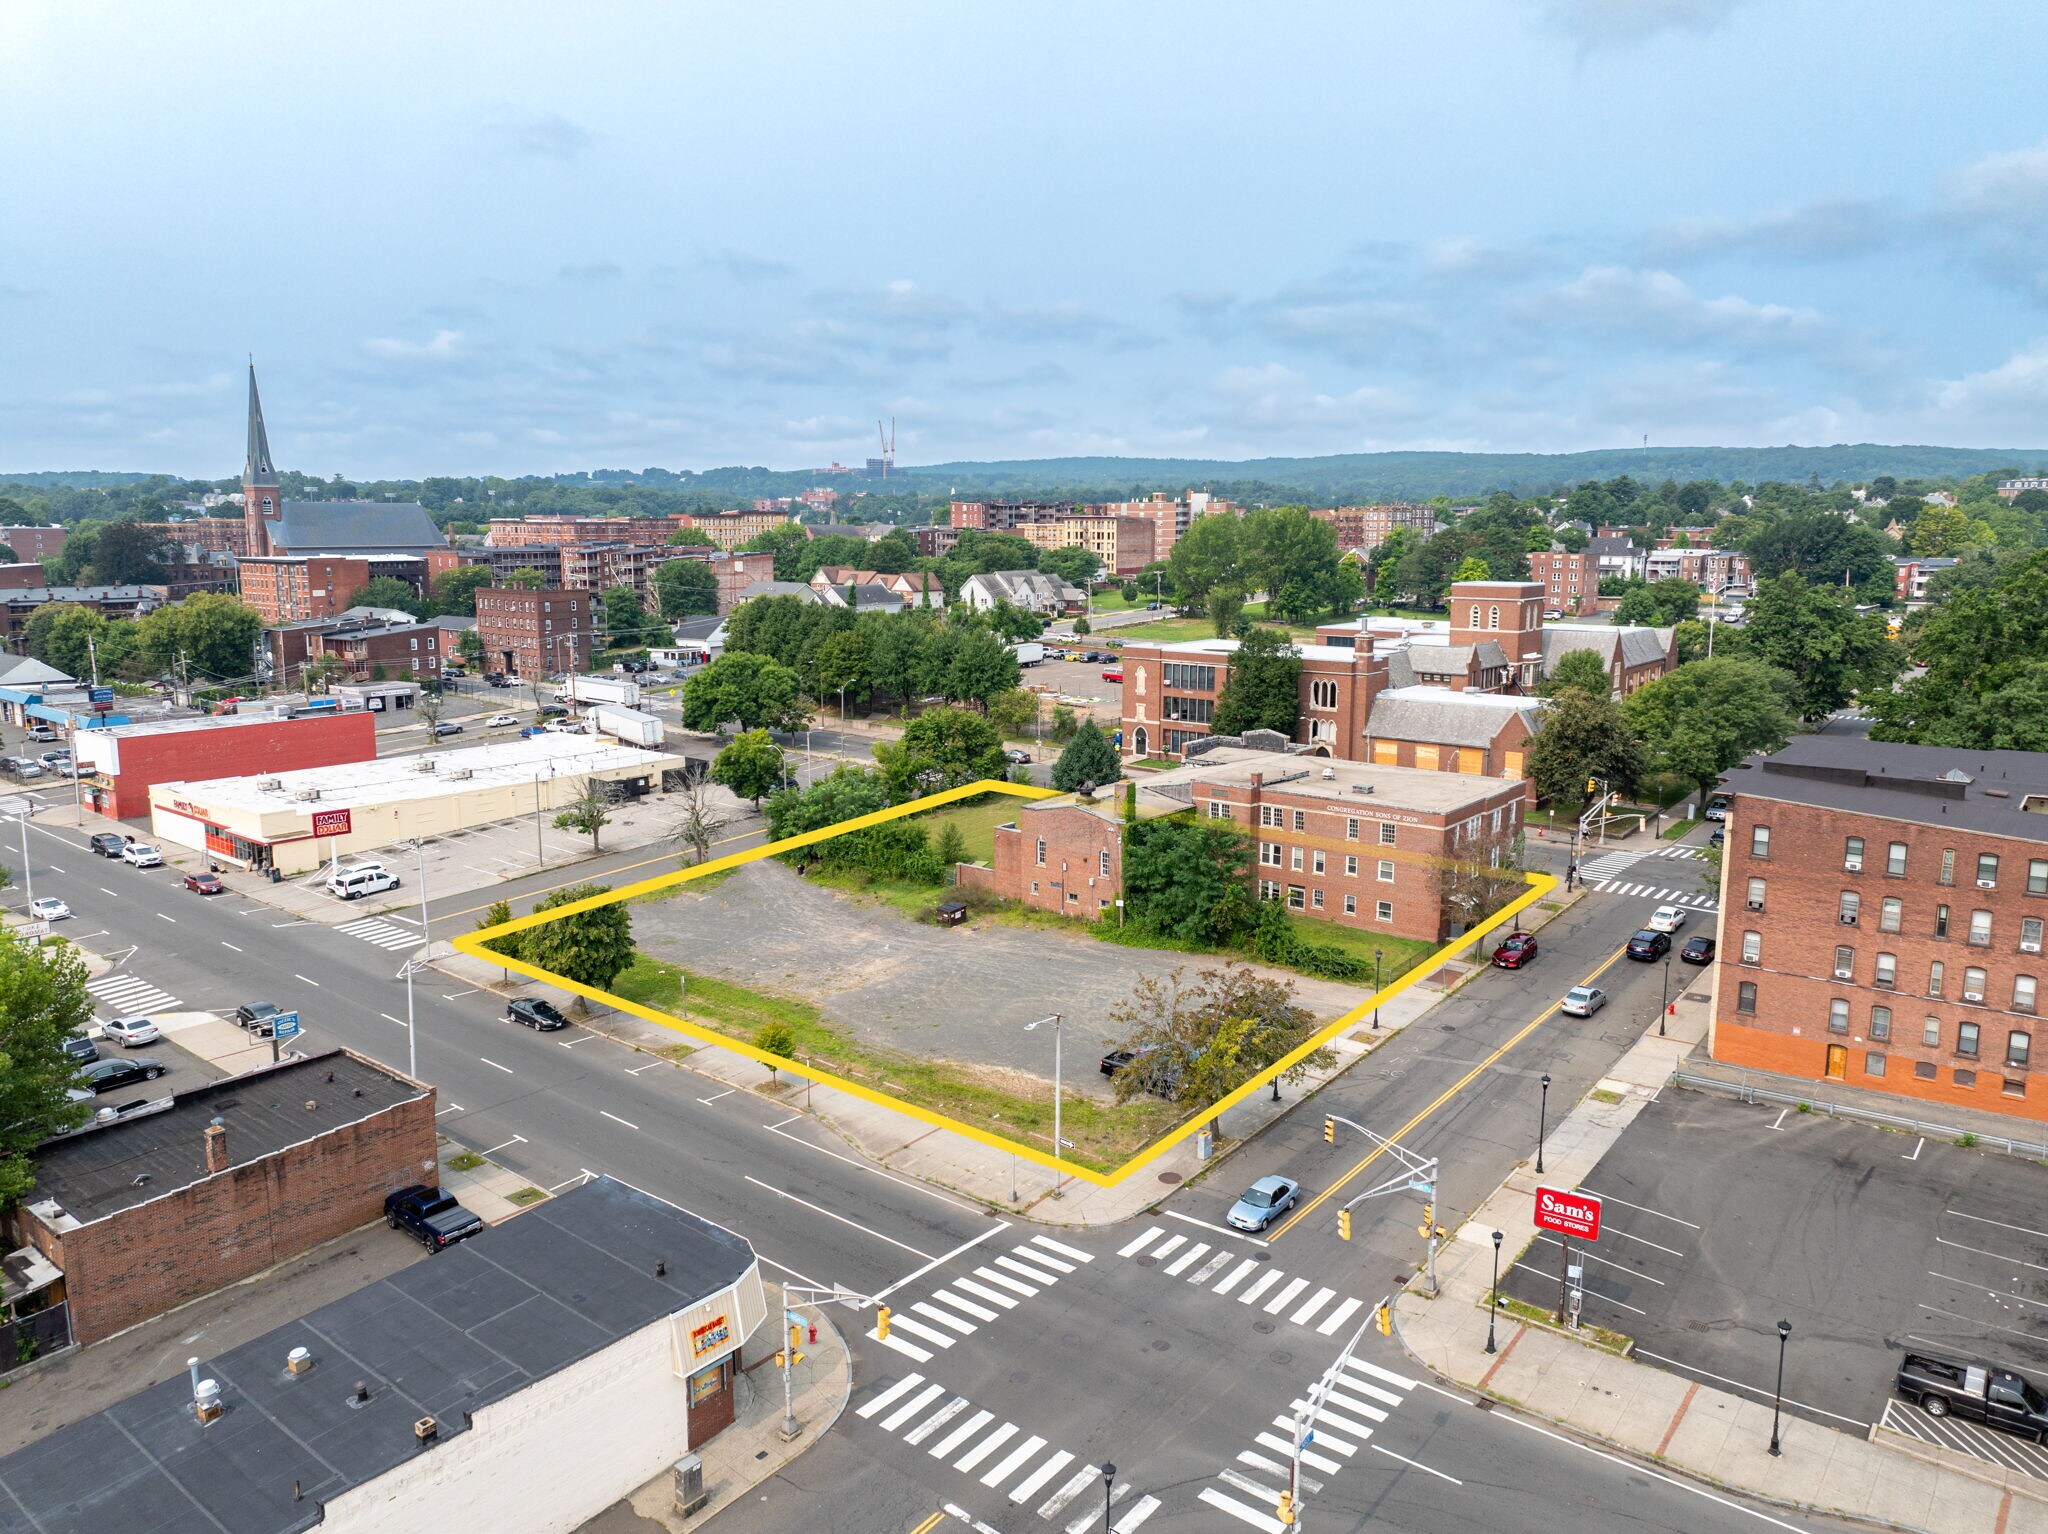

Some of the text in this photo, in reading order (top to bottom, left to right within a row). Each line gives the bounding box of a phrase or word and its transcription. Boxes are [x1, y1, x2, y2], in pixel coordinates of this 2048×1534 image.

[316, 812, 348, 826] FAMILY
[1327, 805, 1374, 817] CONGREGATION
[1375, 811, 1391, 820] SONS
[1402, 815, 1418, 823] ZION
[316, 822, 348, 836] DOLLAR
[1541, 1194, 1594, 1221] Sam's
[1543, 1215, 1590, 1232] FOOD STORES
